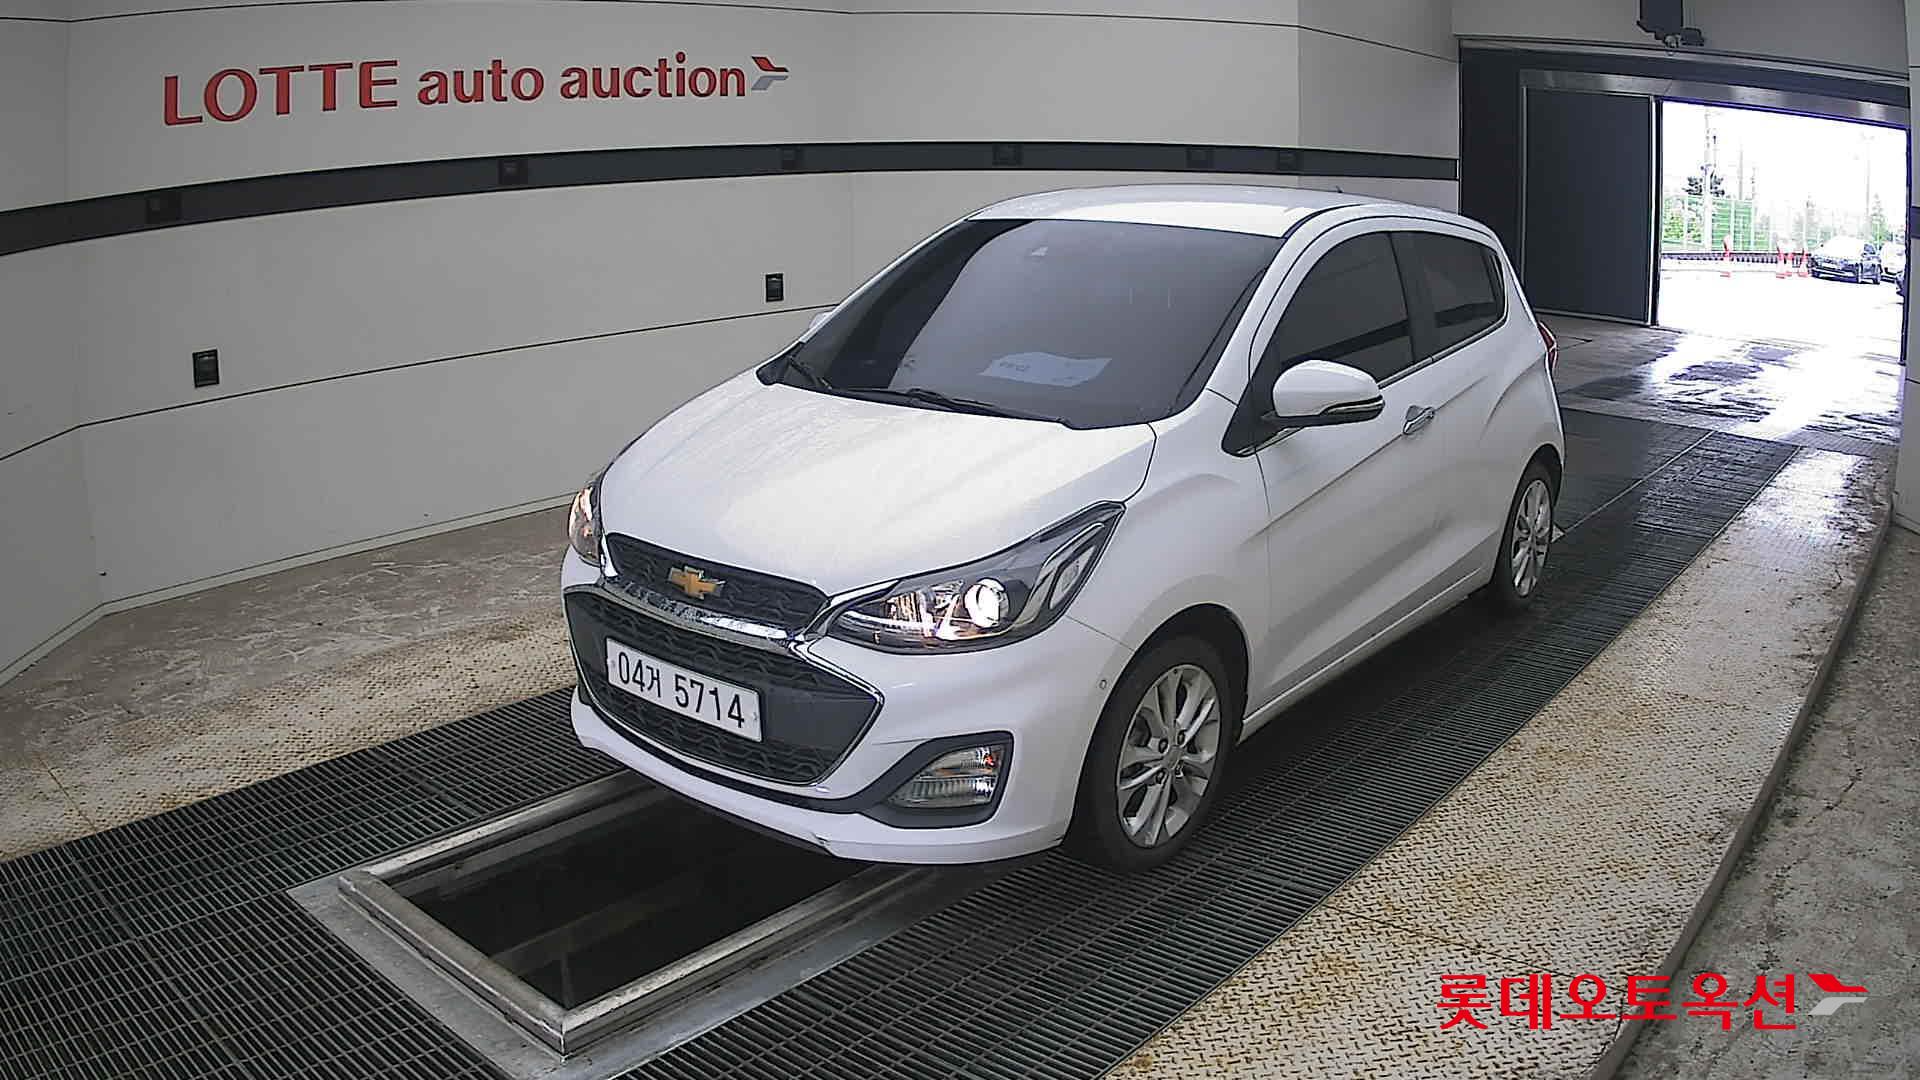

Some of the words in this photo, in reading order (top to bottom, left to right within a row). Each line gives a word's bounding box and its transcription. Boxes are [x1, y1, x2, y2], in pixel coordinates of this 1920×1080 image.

[164, 60, 398, 126] LOTTE
[417, 59, 545, 104] auto
[560, 51, 746, 99] auction
[674, 674, 745, 729] 5714
